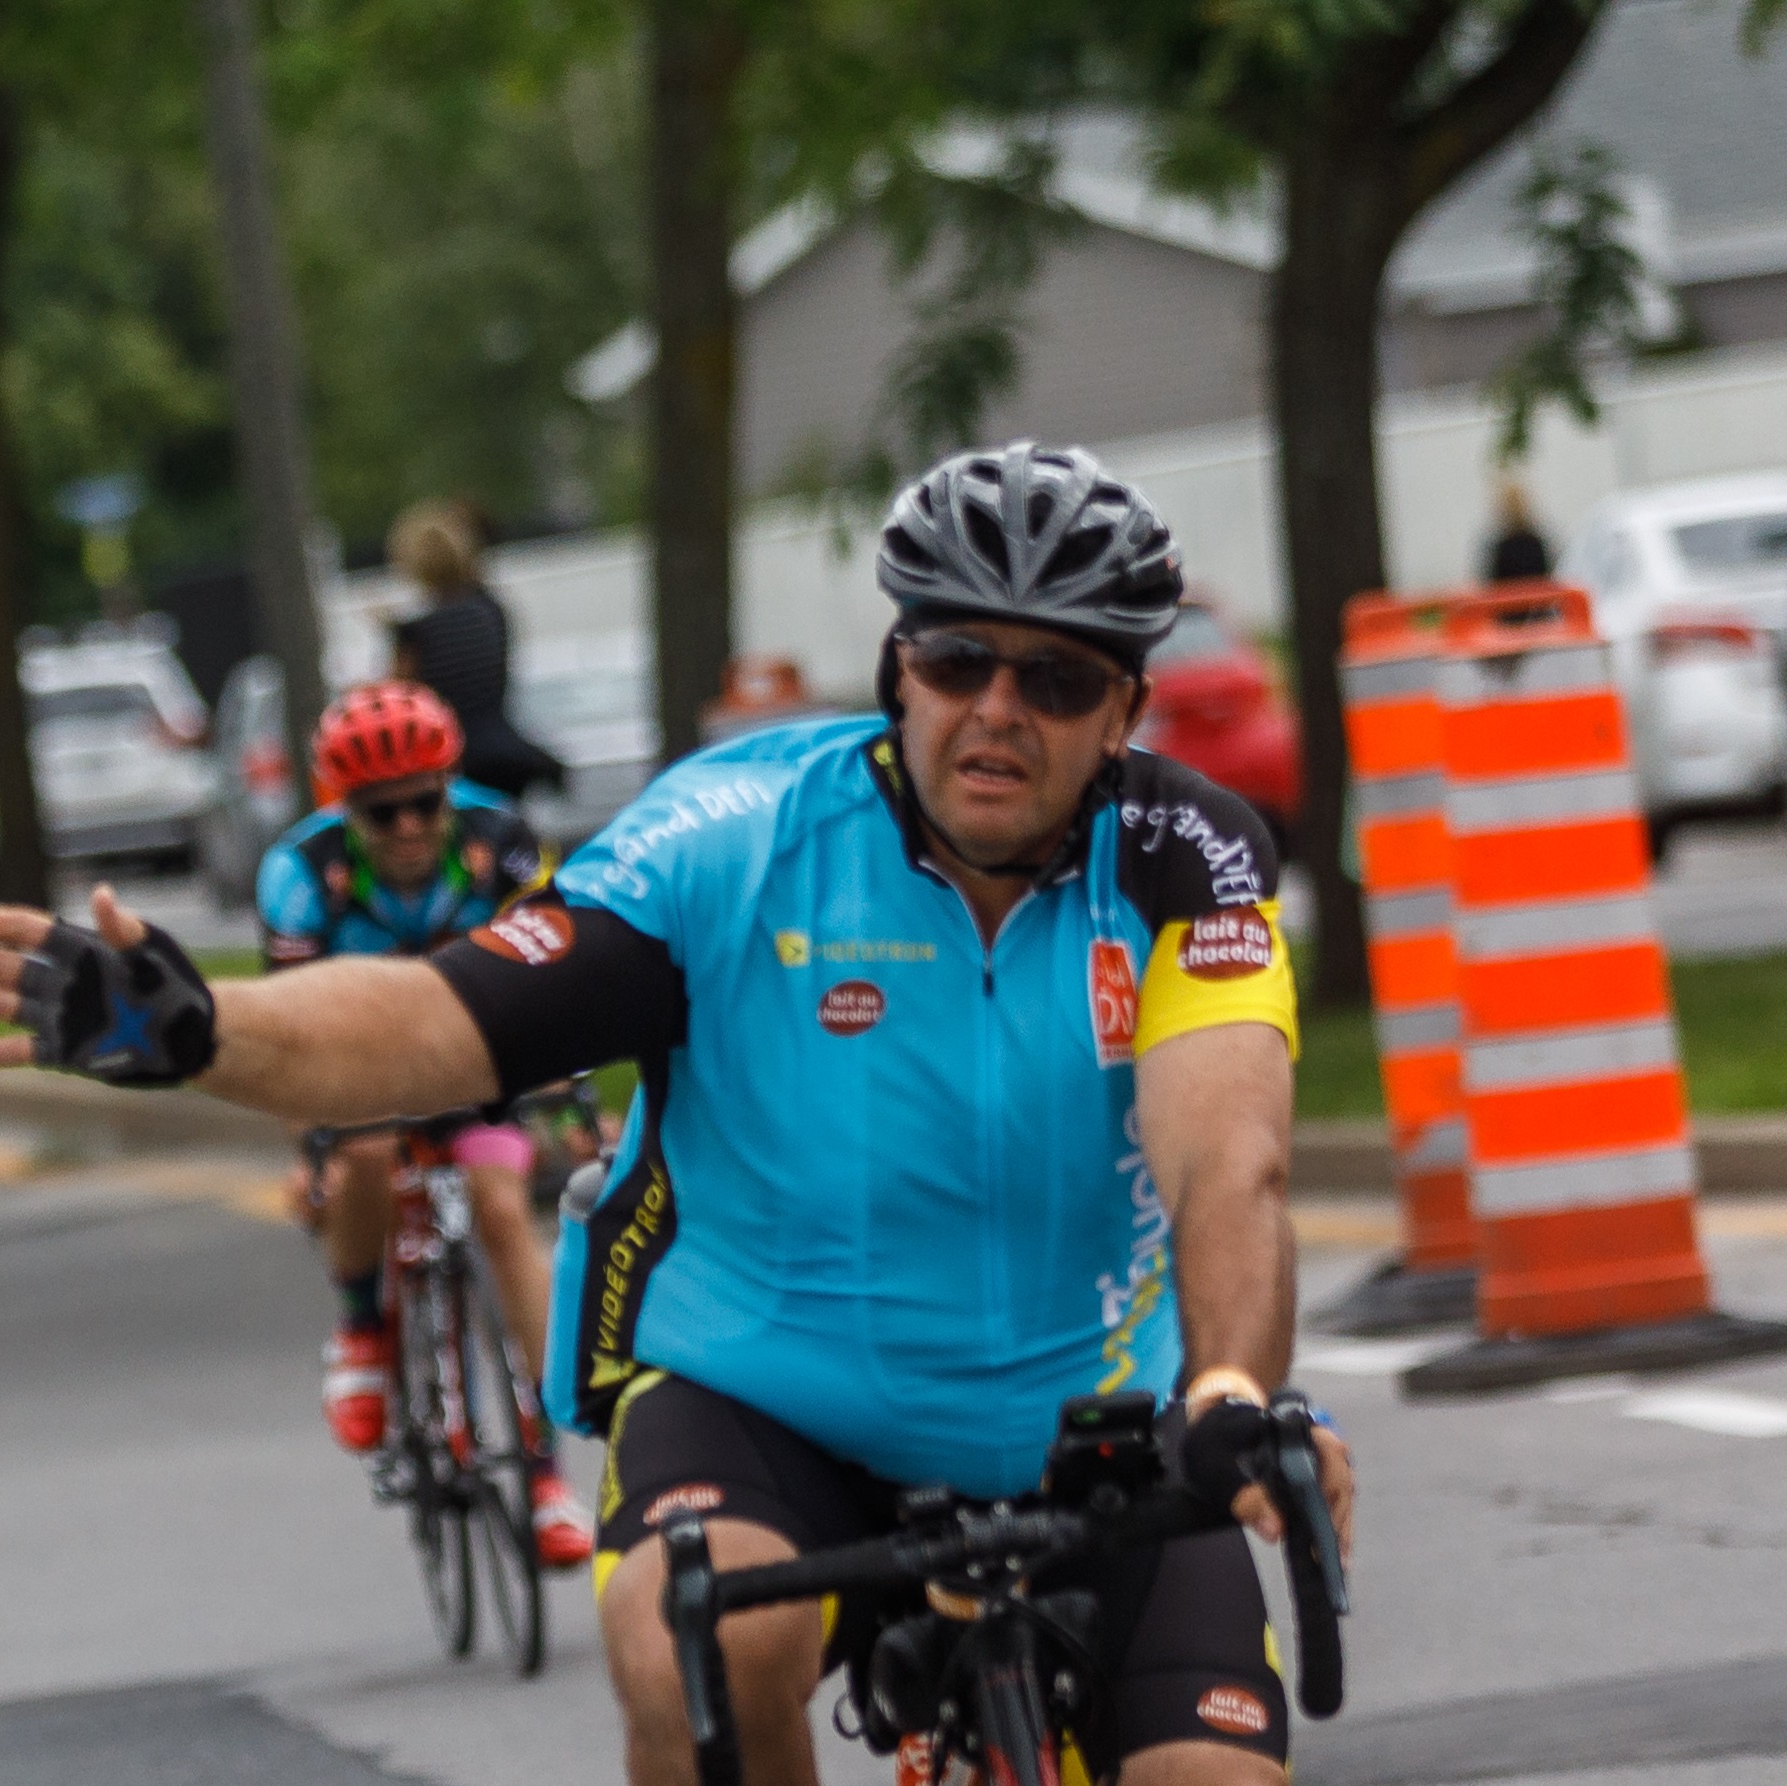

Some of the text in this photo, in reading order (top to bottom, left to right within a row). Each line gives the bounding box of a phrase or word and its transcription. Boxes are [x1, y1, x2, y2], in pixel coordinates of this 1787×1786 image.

[1141, 802, 1247, 872] grand
[1193, 917, 1267, 946] lait au
